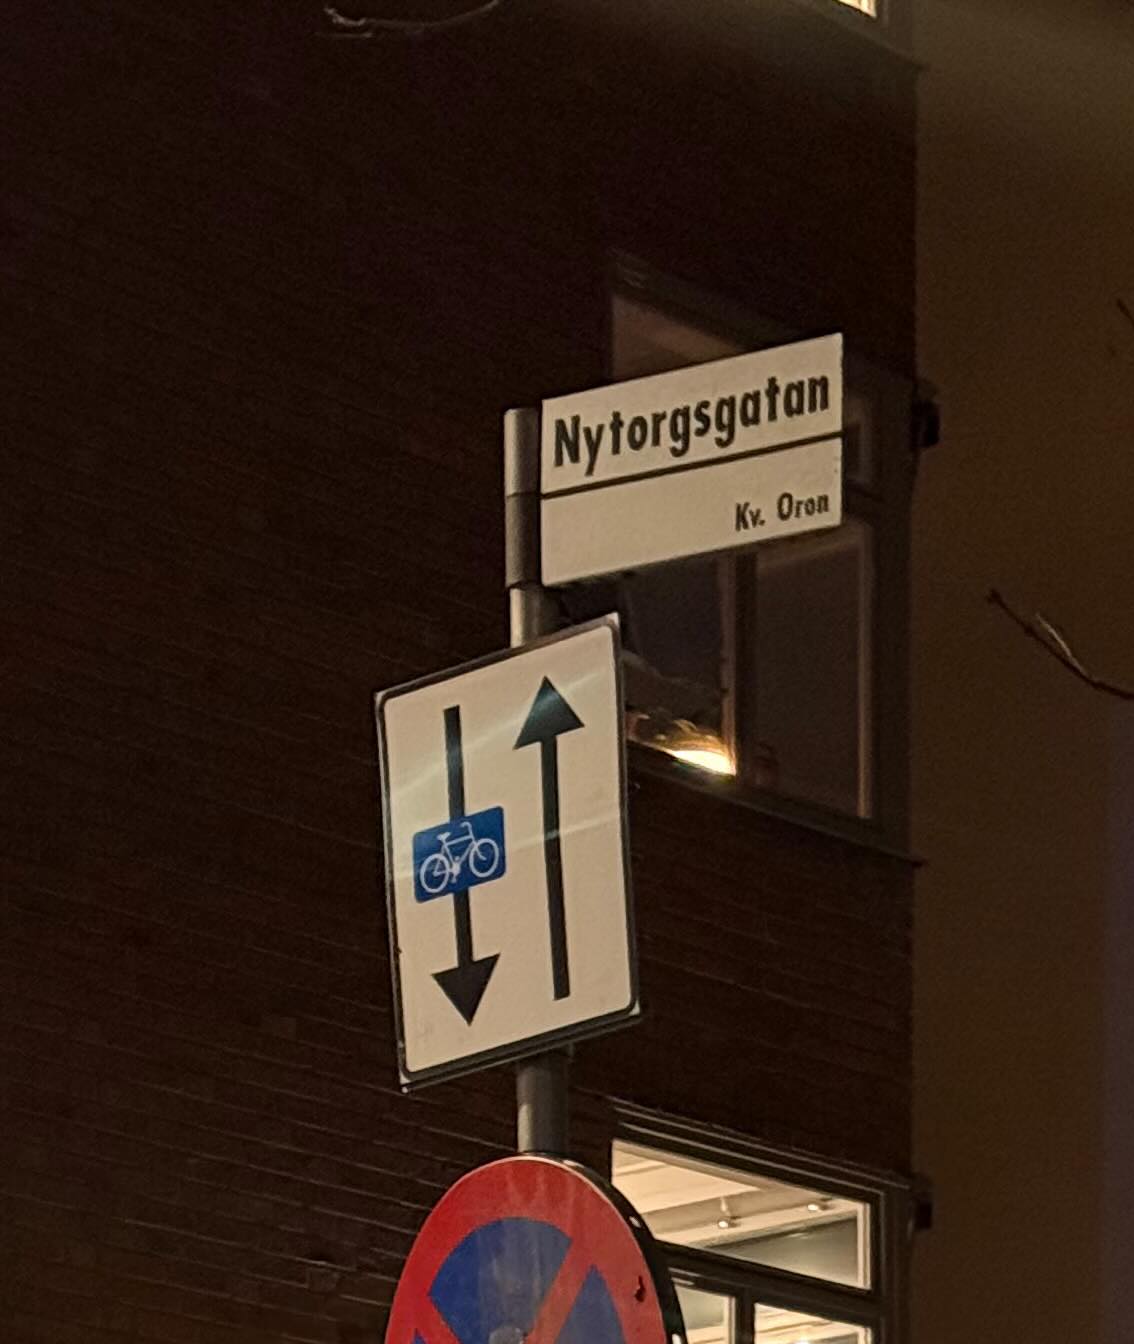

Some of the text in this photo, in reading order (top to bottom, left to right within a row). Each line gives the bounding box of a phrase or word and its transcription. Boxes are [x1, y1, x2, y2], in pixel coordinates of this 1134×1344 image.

[553, 374, 830, 477] Nytorgsgatan
[734, 493, 829, 531] Kv. Oron
